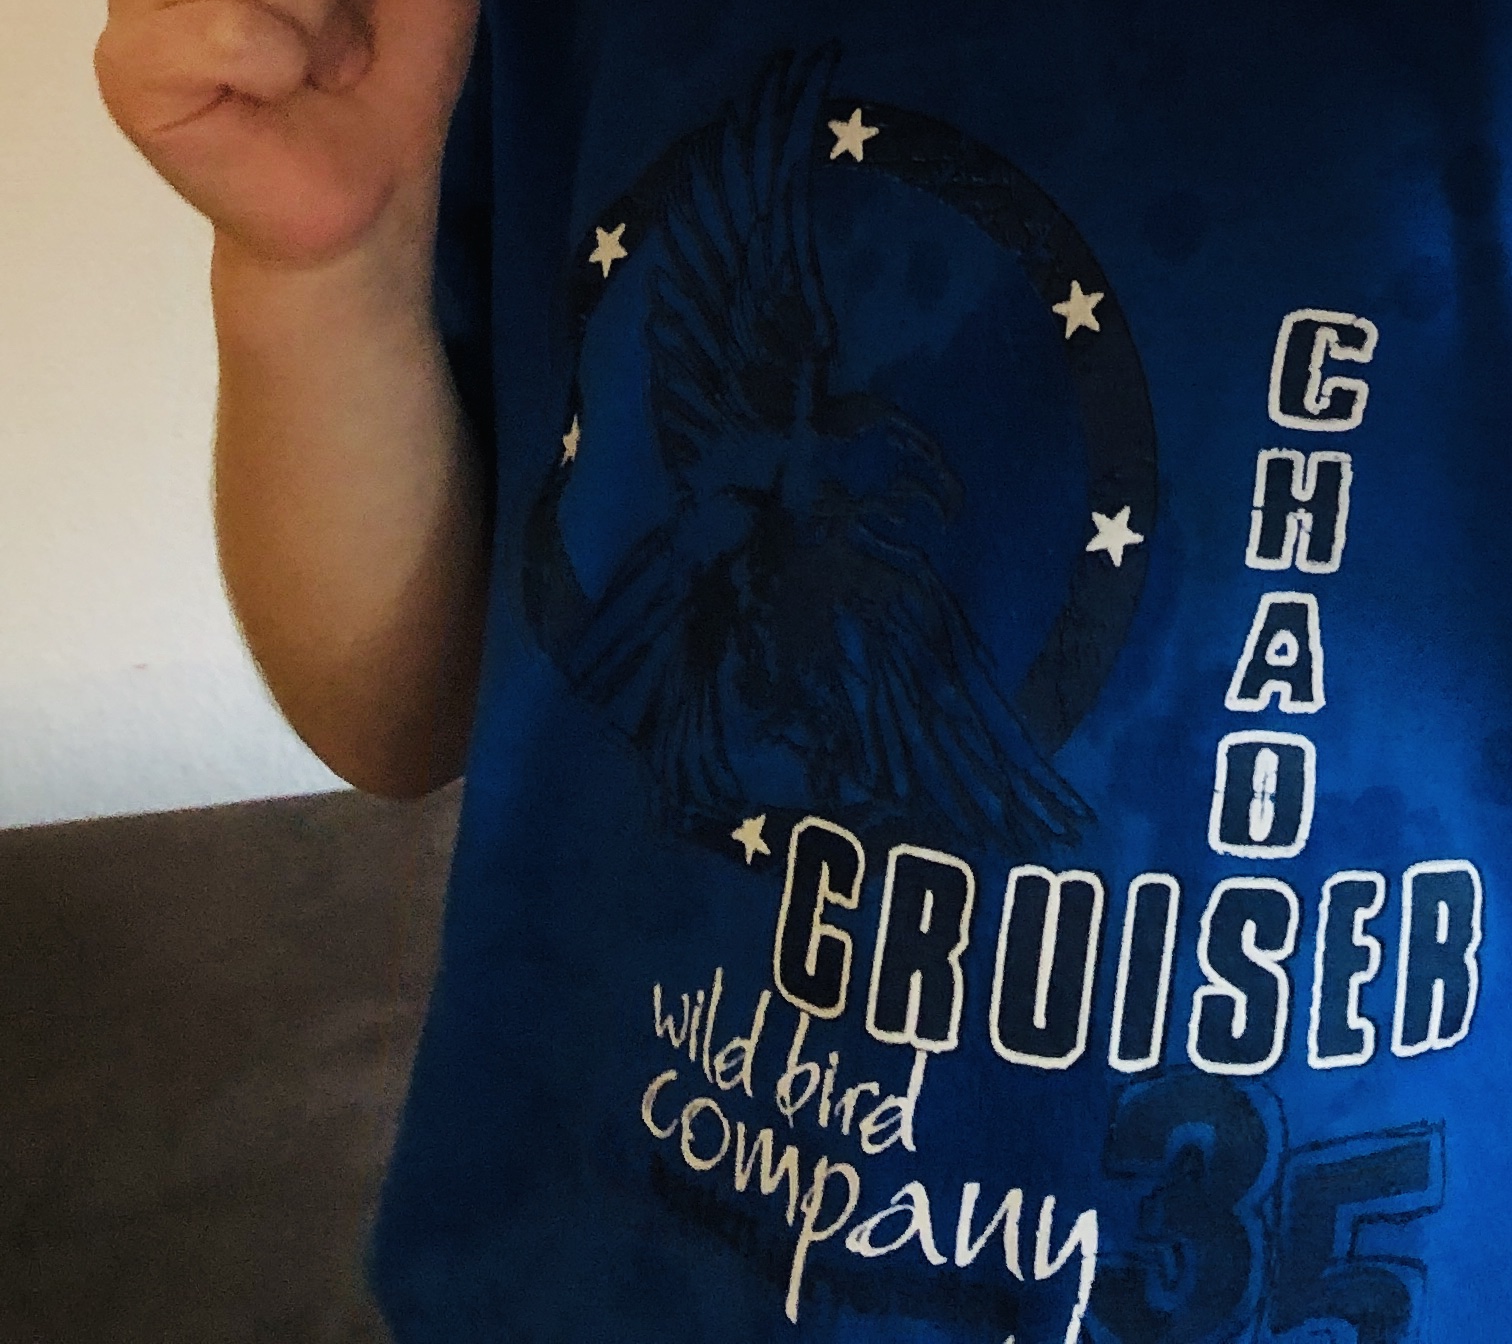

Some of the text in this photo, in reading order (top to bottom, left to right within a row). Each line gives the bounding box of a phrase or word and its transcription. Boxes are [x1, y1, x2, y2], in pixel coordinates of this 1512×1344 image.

[652, 968, 927, 1154] wild bird
[773, 815, 1482, 1077] CRUISER
[642, 1068, 1098, 1344] company
